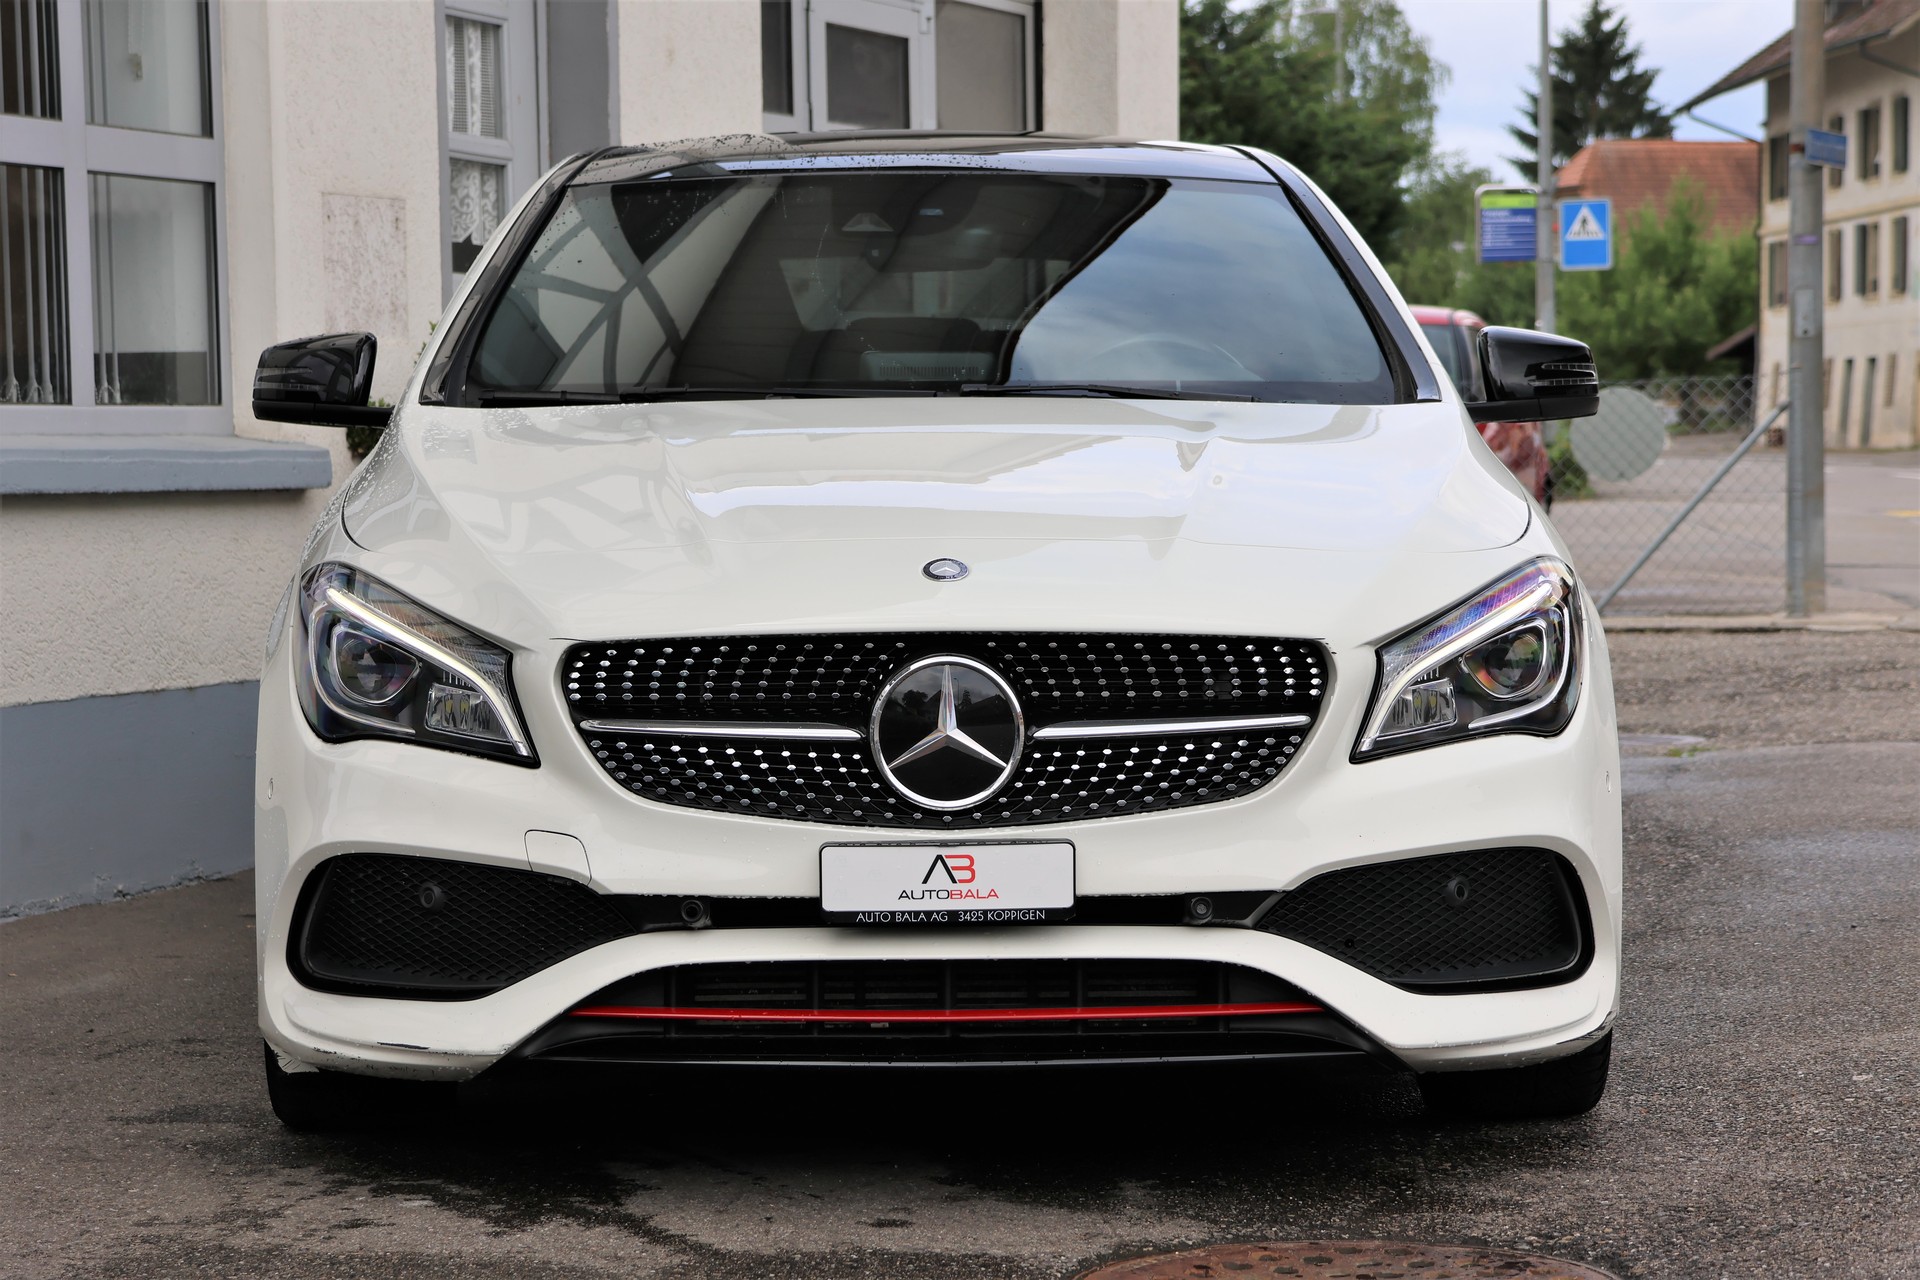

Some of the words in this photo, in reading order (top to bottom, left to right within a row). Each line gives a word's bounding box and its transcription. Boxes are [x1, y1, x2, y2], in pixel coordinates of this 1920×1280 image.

[921, 854, 976, 884] AB
[898, 888, 999, 900] AUTOBALA
[856, 911, 891, 922] AUTO
[895, 911, 927, 922] BALA
[930, 911, 948, 922] AG
[958, 910, 984, 921] 3425
[987, 909, 1045, 921] KOPPIGEN
